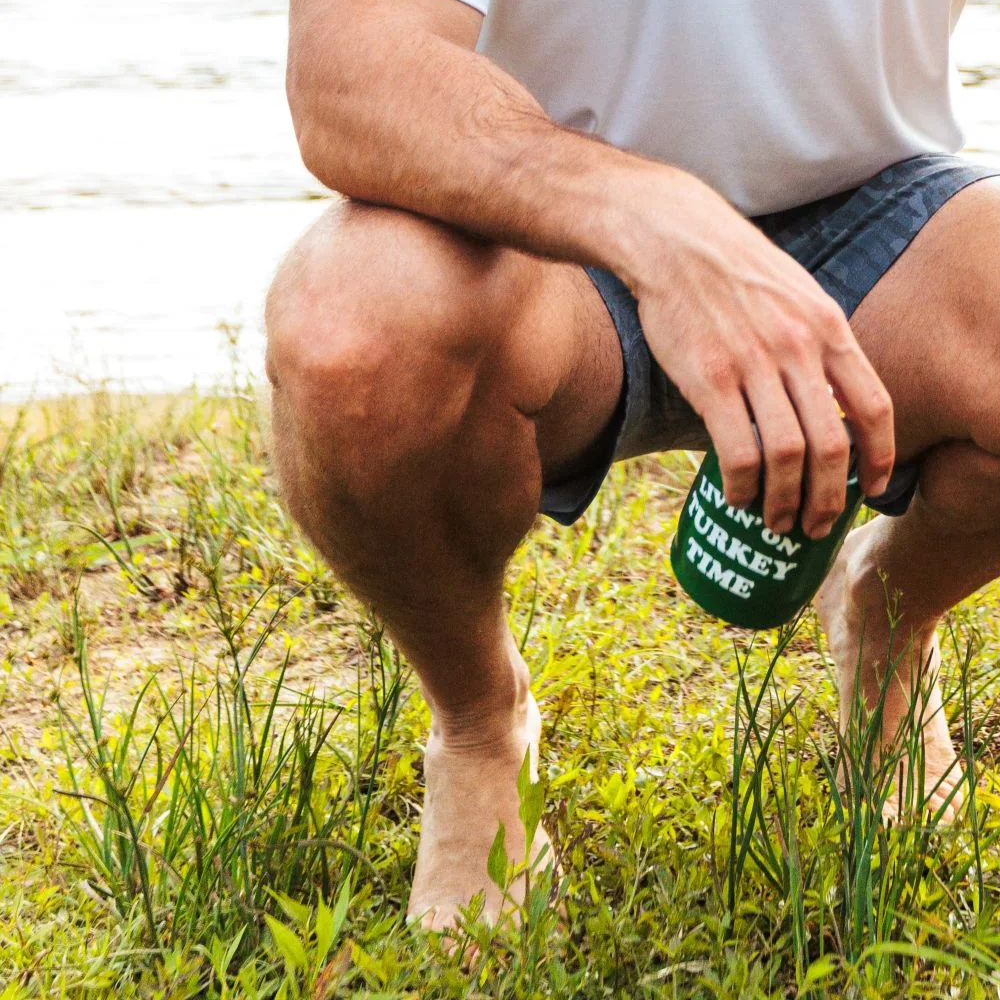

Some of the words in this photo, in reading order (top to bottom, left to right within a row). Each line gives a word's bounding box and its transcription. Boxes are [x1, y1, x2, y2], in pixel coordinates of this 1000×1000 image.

[688, 490, 798, 580] TURKEY
[761, 527, 802, 556] ON
[686, 536, 755, 599] TIME
